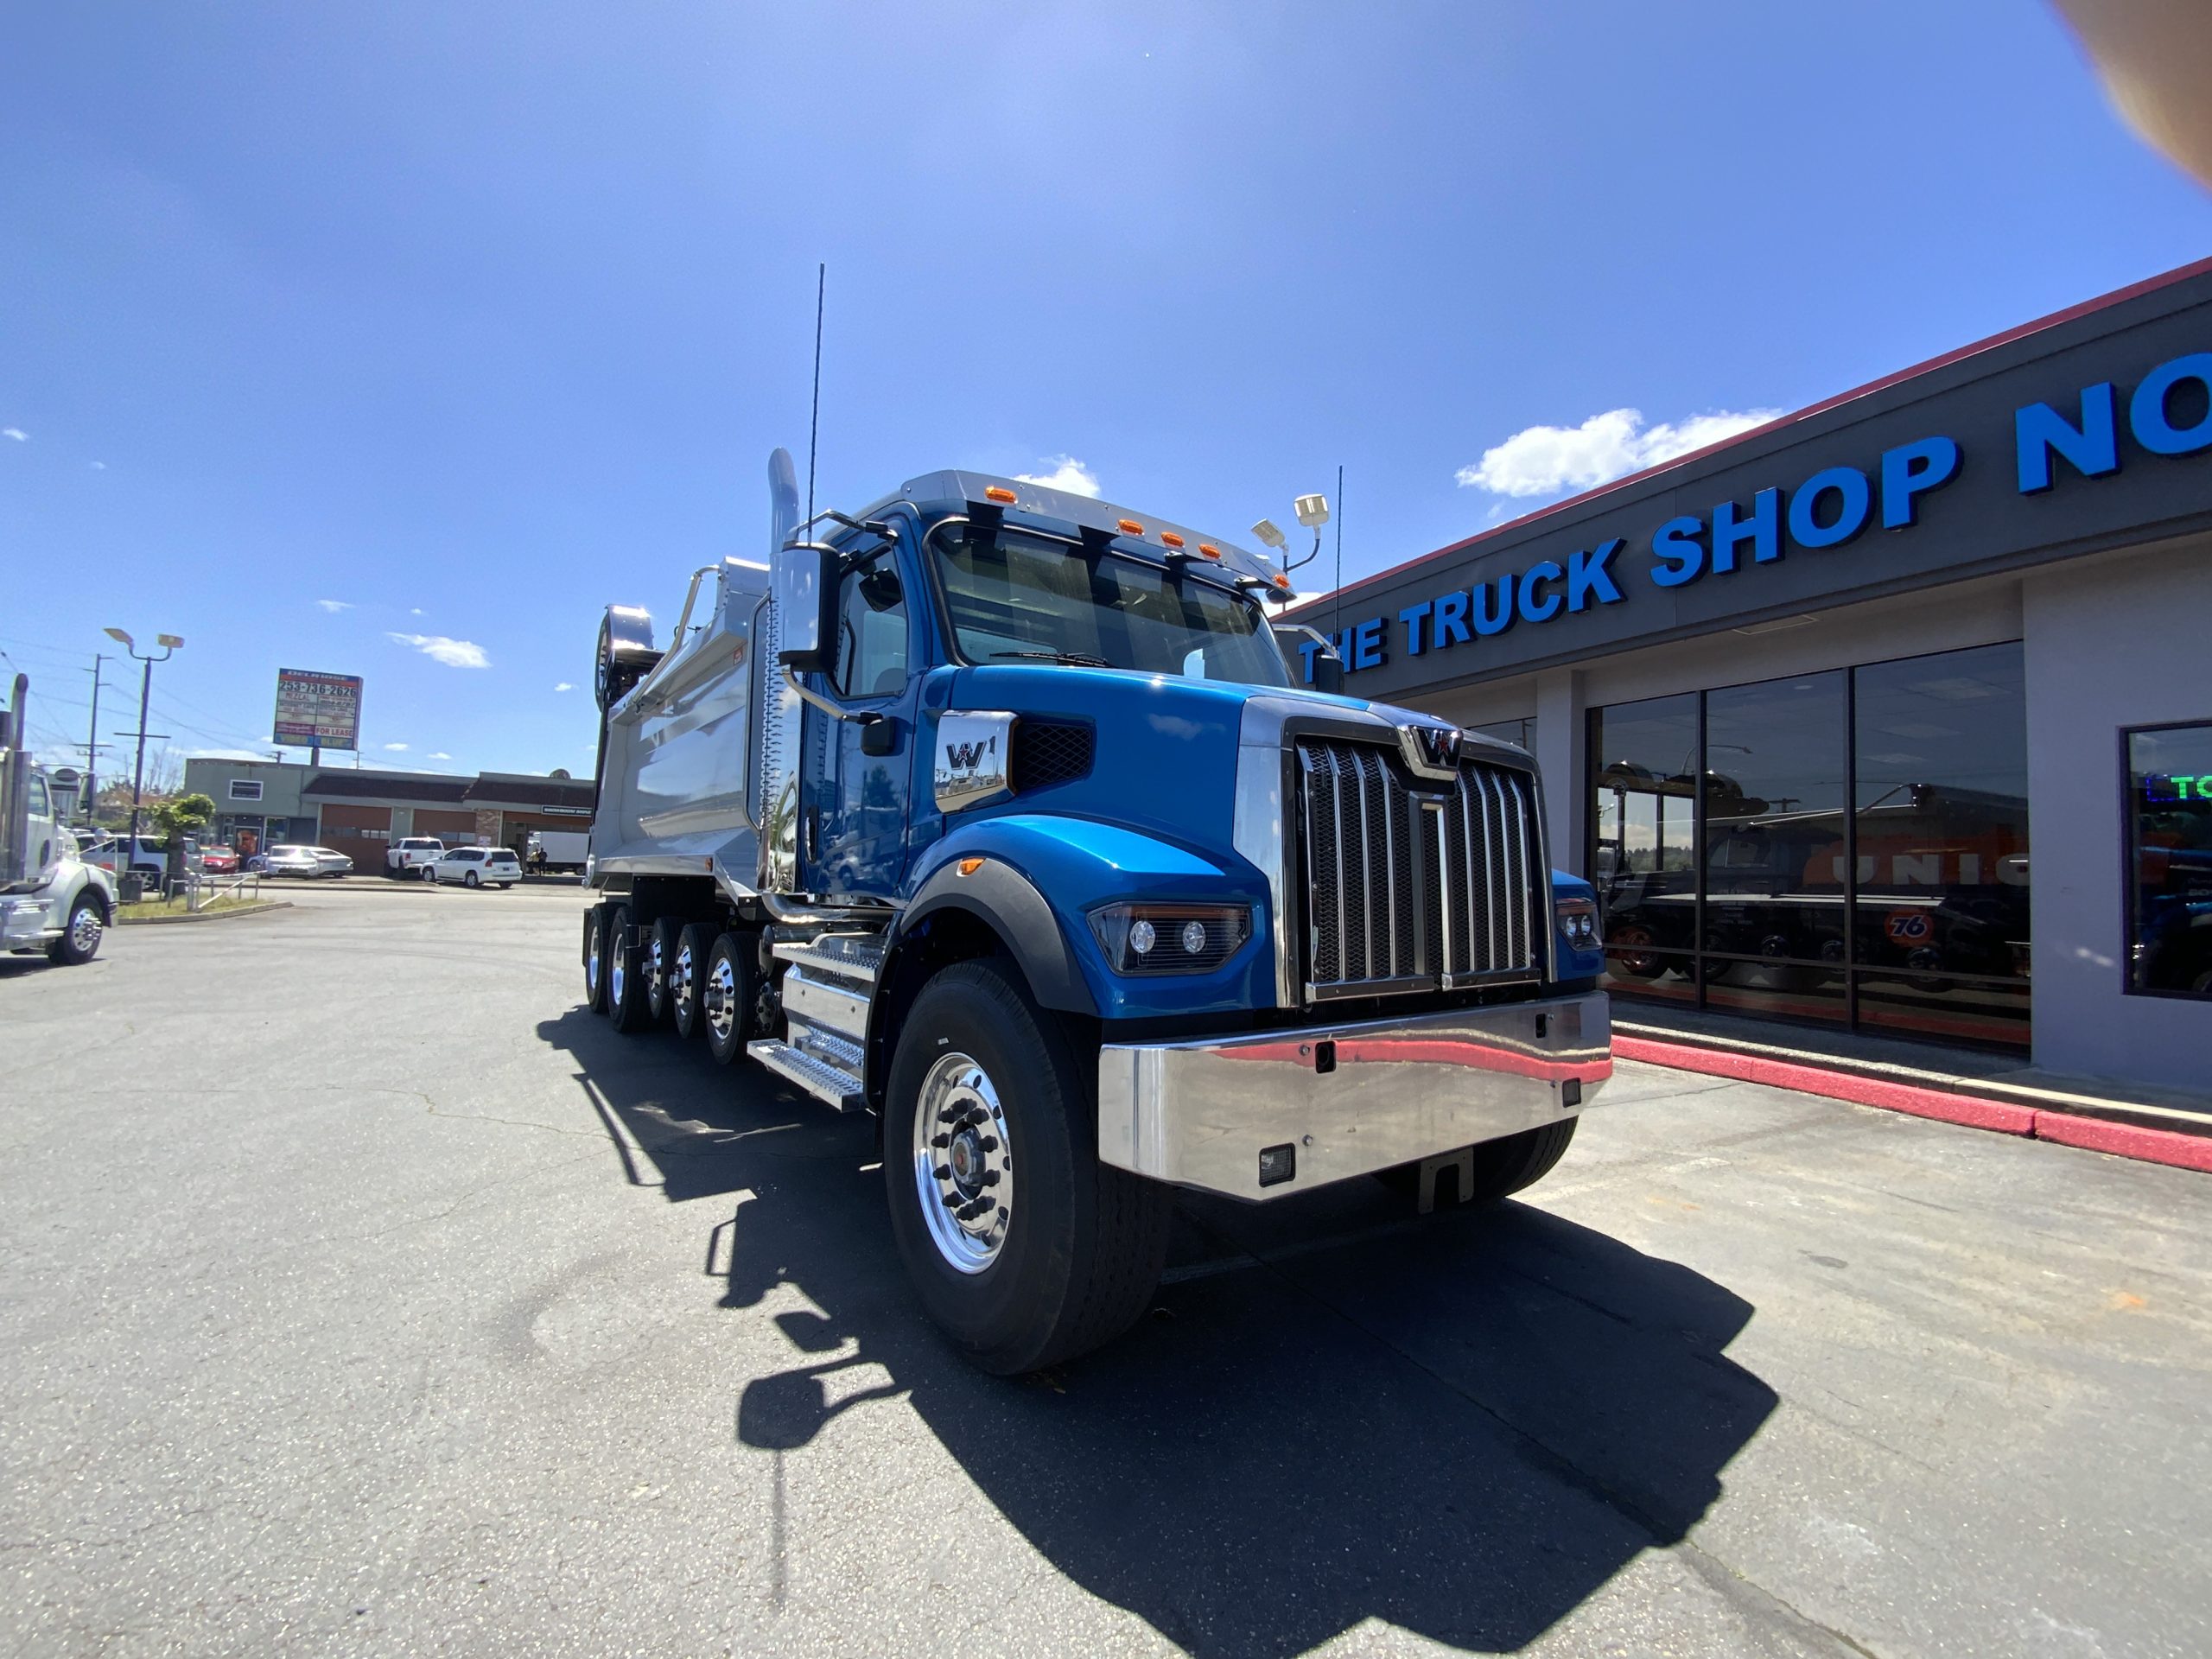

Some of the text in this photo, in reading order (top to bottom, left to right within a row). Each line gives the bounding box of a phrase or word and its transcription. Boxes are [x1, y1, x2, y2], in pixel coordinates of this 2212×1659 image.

[1298, 353, 2212, 684] THE TRUCK SHOP NO
[332, 728, 353, 737] LEASE
[1888, 915, 1928, 938] 76
